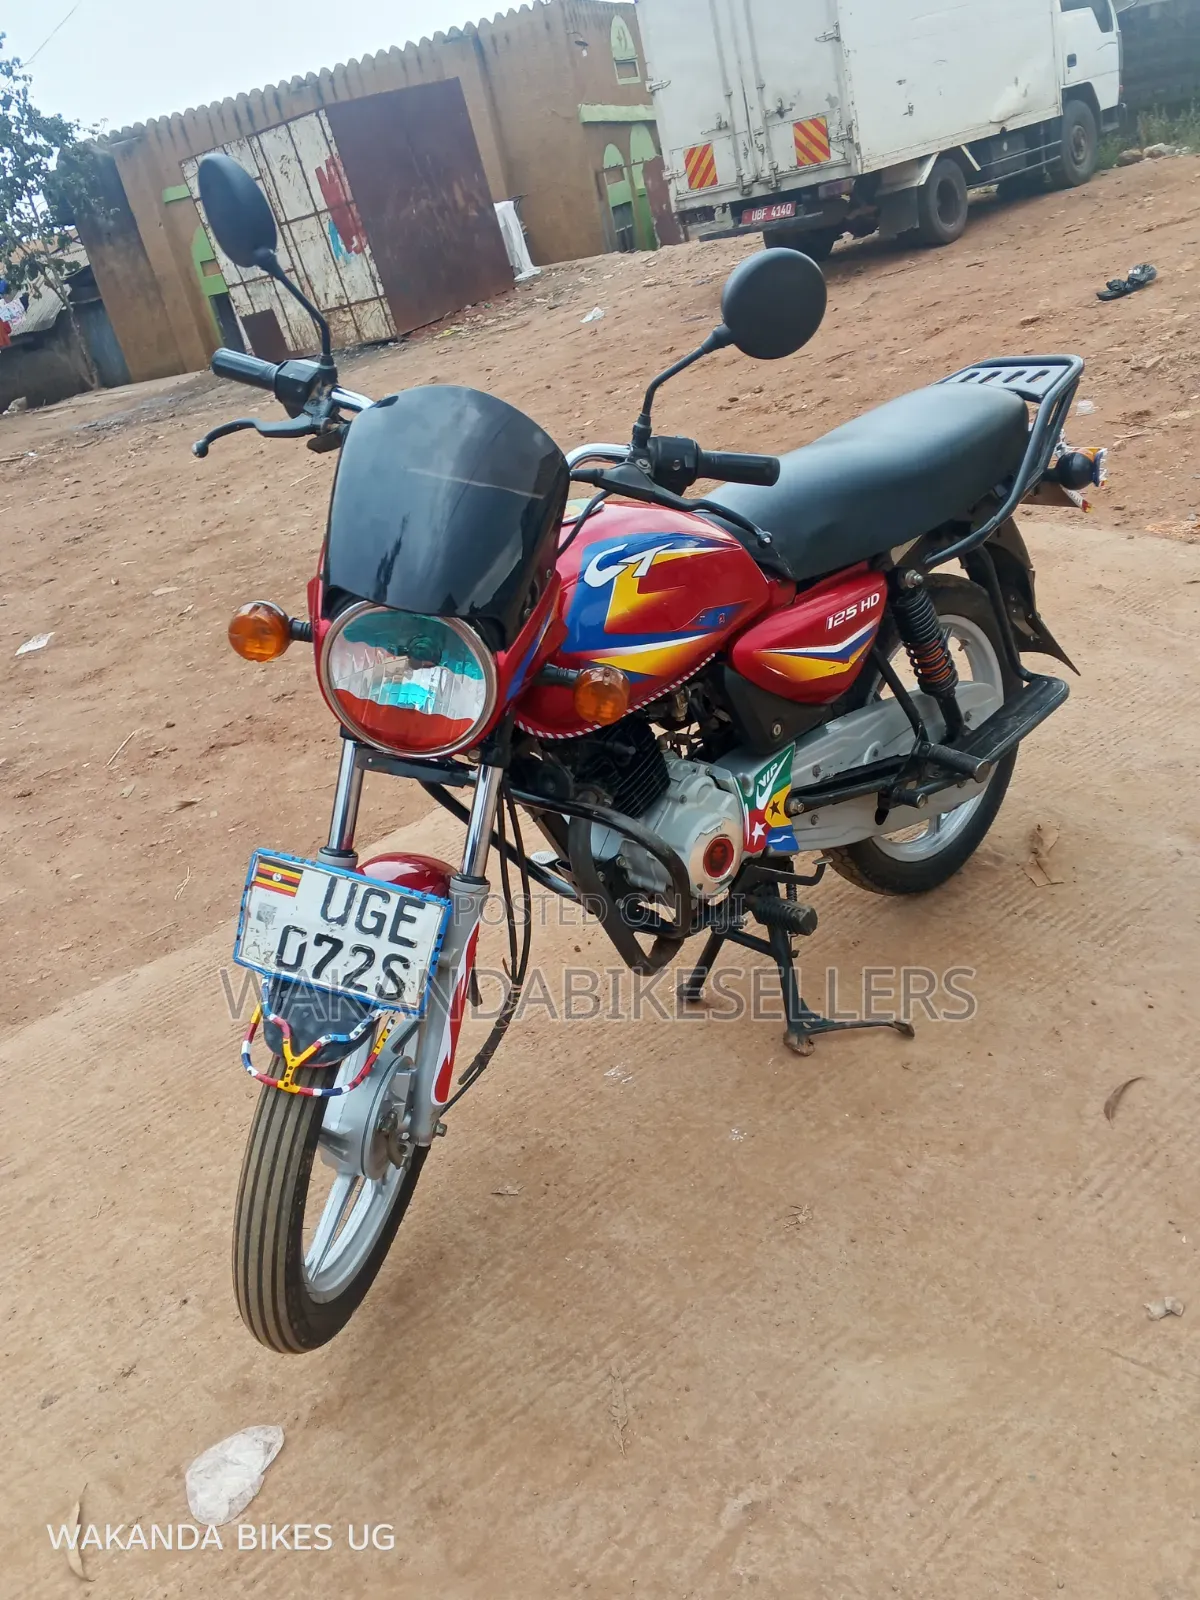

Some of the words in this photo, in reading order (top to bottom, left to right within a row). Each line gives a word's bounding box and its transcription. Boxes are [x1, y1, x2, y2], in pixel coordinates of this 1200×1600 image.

[751, 208, 768, 221] UBF
[584, 542, 675, 588] CT
[826, 604, 858, 630] 125
[860, 592, 880, 613] HD
[757, 762, 778, 787] VIP
[320, 876, 427, 948] UGE
[276, 925, 411, 1001] 072S
